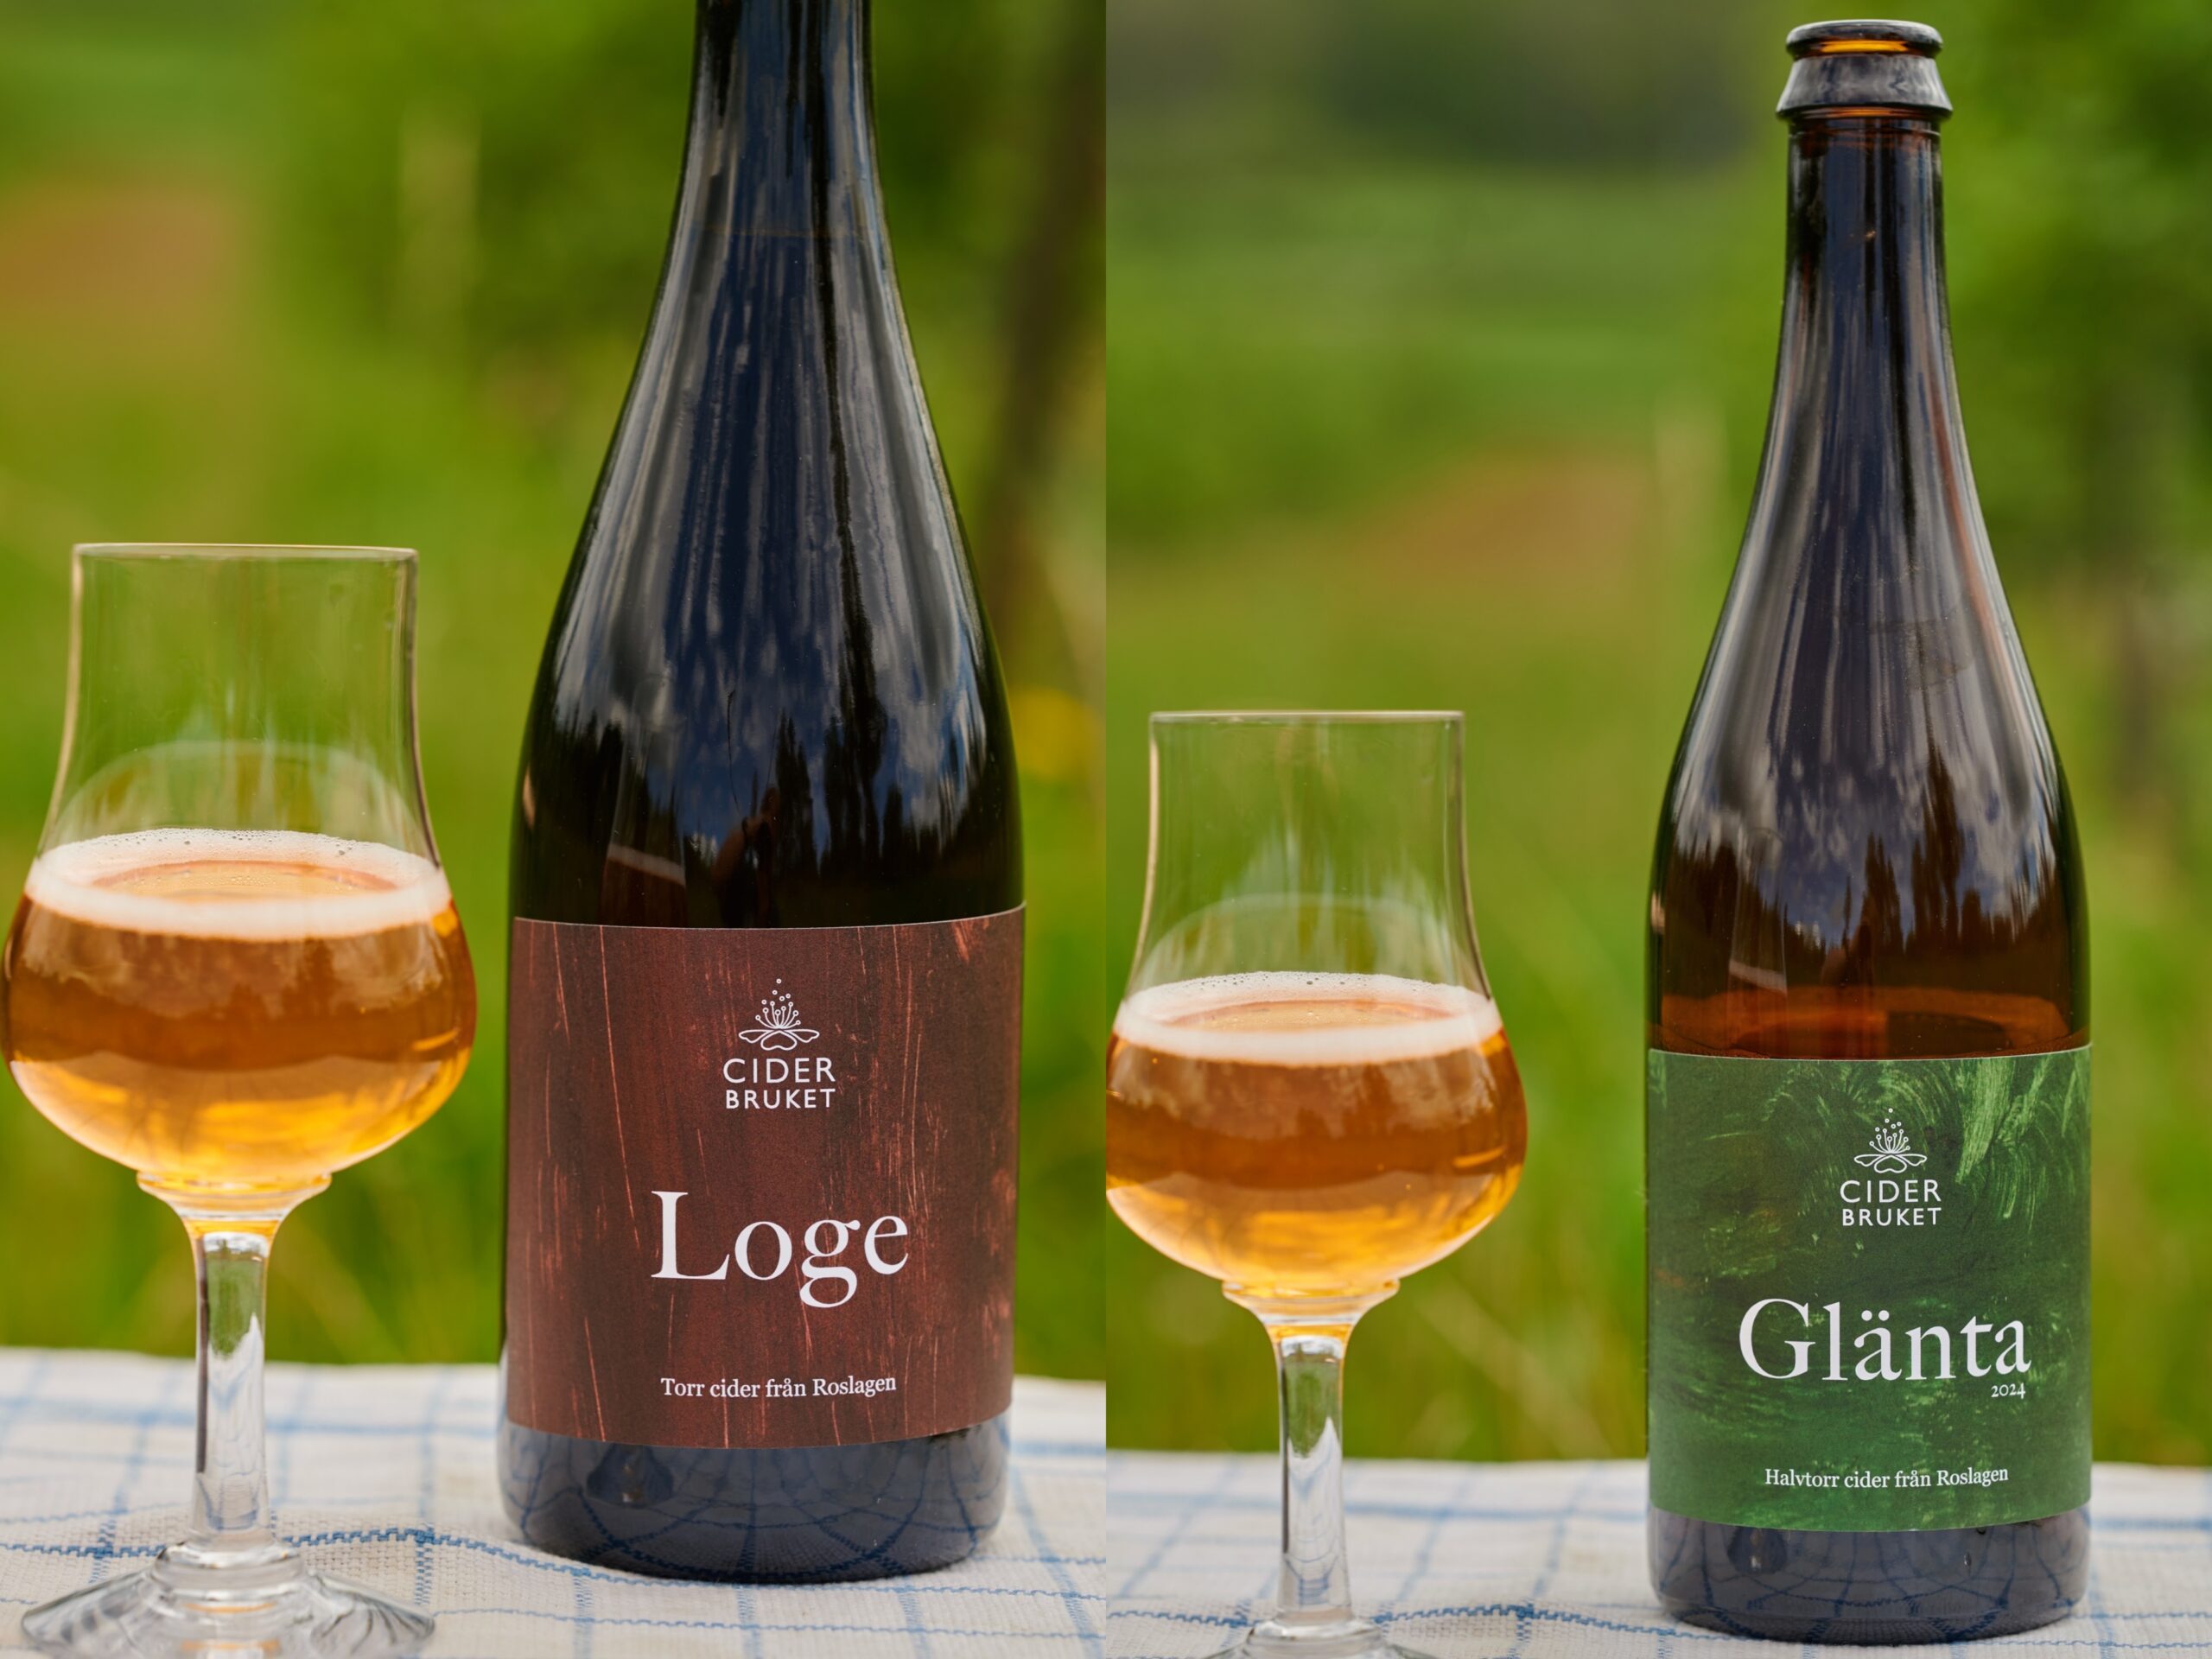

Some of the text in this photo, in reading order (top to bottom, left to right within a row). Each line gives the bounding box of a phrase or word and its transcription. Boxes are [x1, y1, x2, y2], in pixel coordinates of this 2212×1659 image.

[722, 1057, 836, 1084] CIDER
[725, 1088, 836, 1109] BRUKET
[1840, 1179, 1942, 1204] CIDER
[1842, 1206, 1942, 1227] BRUKET
[651, 1190, 909, 1308] Loge
[1738, 1298, 2032, 1382] Glänta
[660, 1376, 897, 1398] Torr cider från Roslagen
[1991, 1382, 2026, 1399] 2024
[1764, 1466, 2009, 1489] Halvtorr cider från Roslagen
